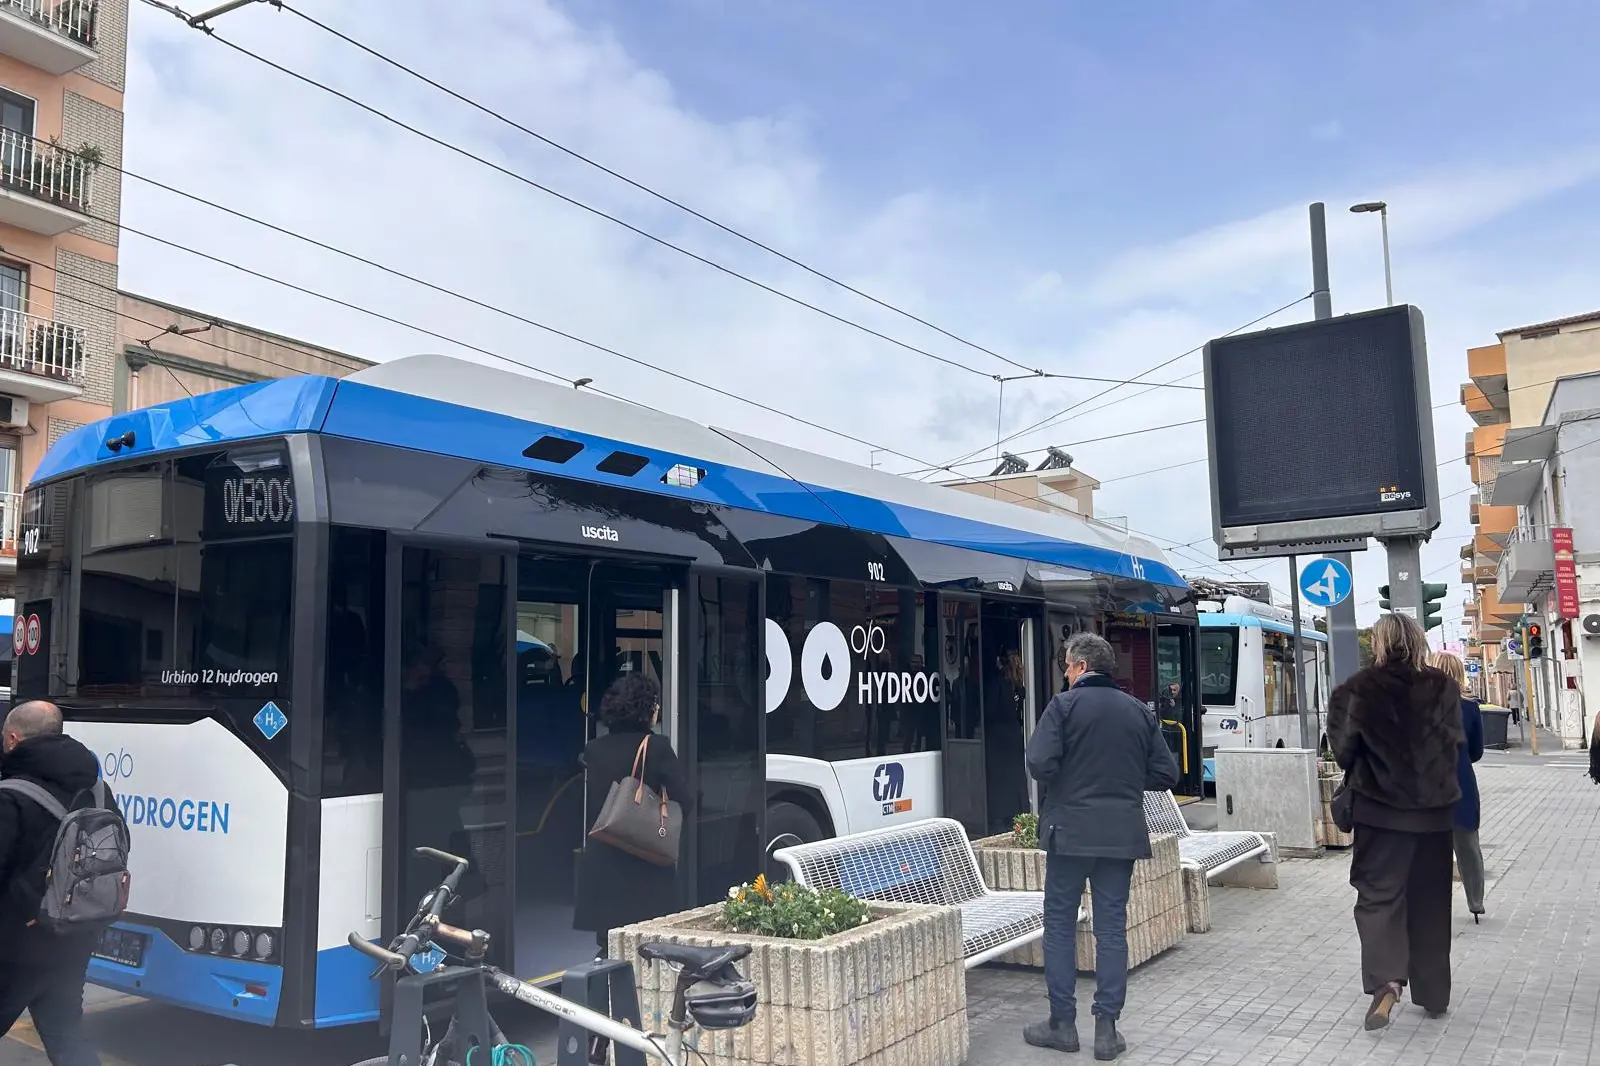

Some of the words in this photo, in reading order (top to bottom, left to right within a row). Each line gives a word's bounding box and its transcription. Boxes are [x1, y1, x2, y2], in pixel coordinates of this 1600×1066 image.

[24, 527, 40, 556] 902
[581, 525, 619, 542] uscita
[867, 561, 885, 582] 902
[161, 670, 199, 685] Urbino
[202, 669, 214, 684] 12
[216, 669, 279, 687] hydrogen
[265, 712, 278, 730] H2
